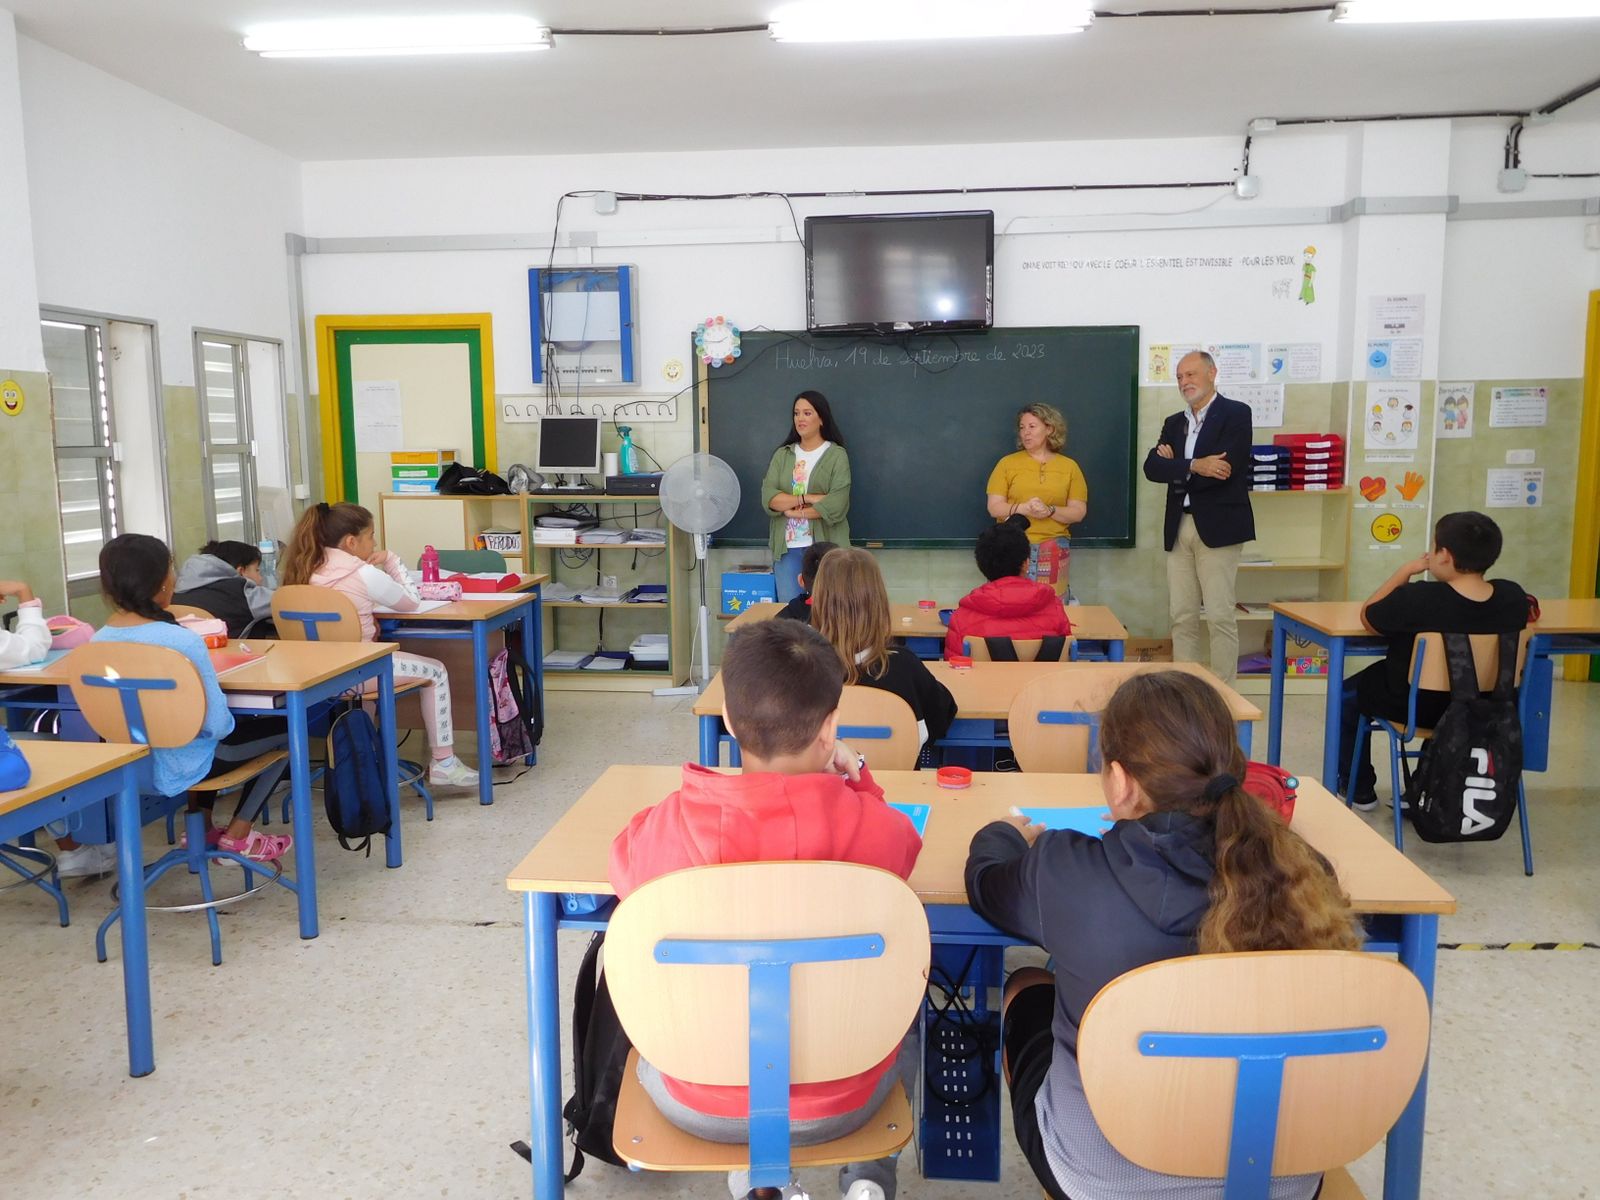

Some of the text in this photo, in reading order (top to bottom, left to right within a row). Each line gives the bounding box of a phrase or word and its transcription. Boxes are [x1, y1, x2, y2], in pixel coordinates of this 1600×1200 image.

[1042, 260, 1057, 269] VOIT
[1185, 257, 1198, 267] EST
[1199, 256, 1233, 267] INVISIBLE
[1261, 255, 1274, 267] LES
[775, 343, 839, 370] Huelva,
[845, 346, 868, 366] 19
[872, 348, 892, 366] de
[985, 344, 1007, 361] de
[1012, 342, 1047, 359] 2023
[1460, 747, 1497, 835] FILA
